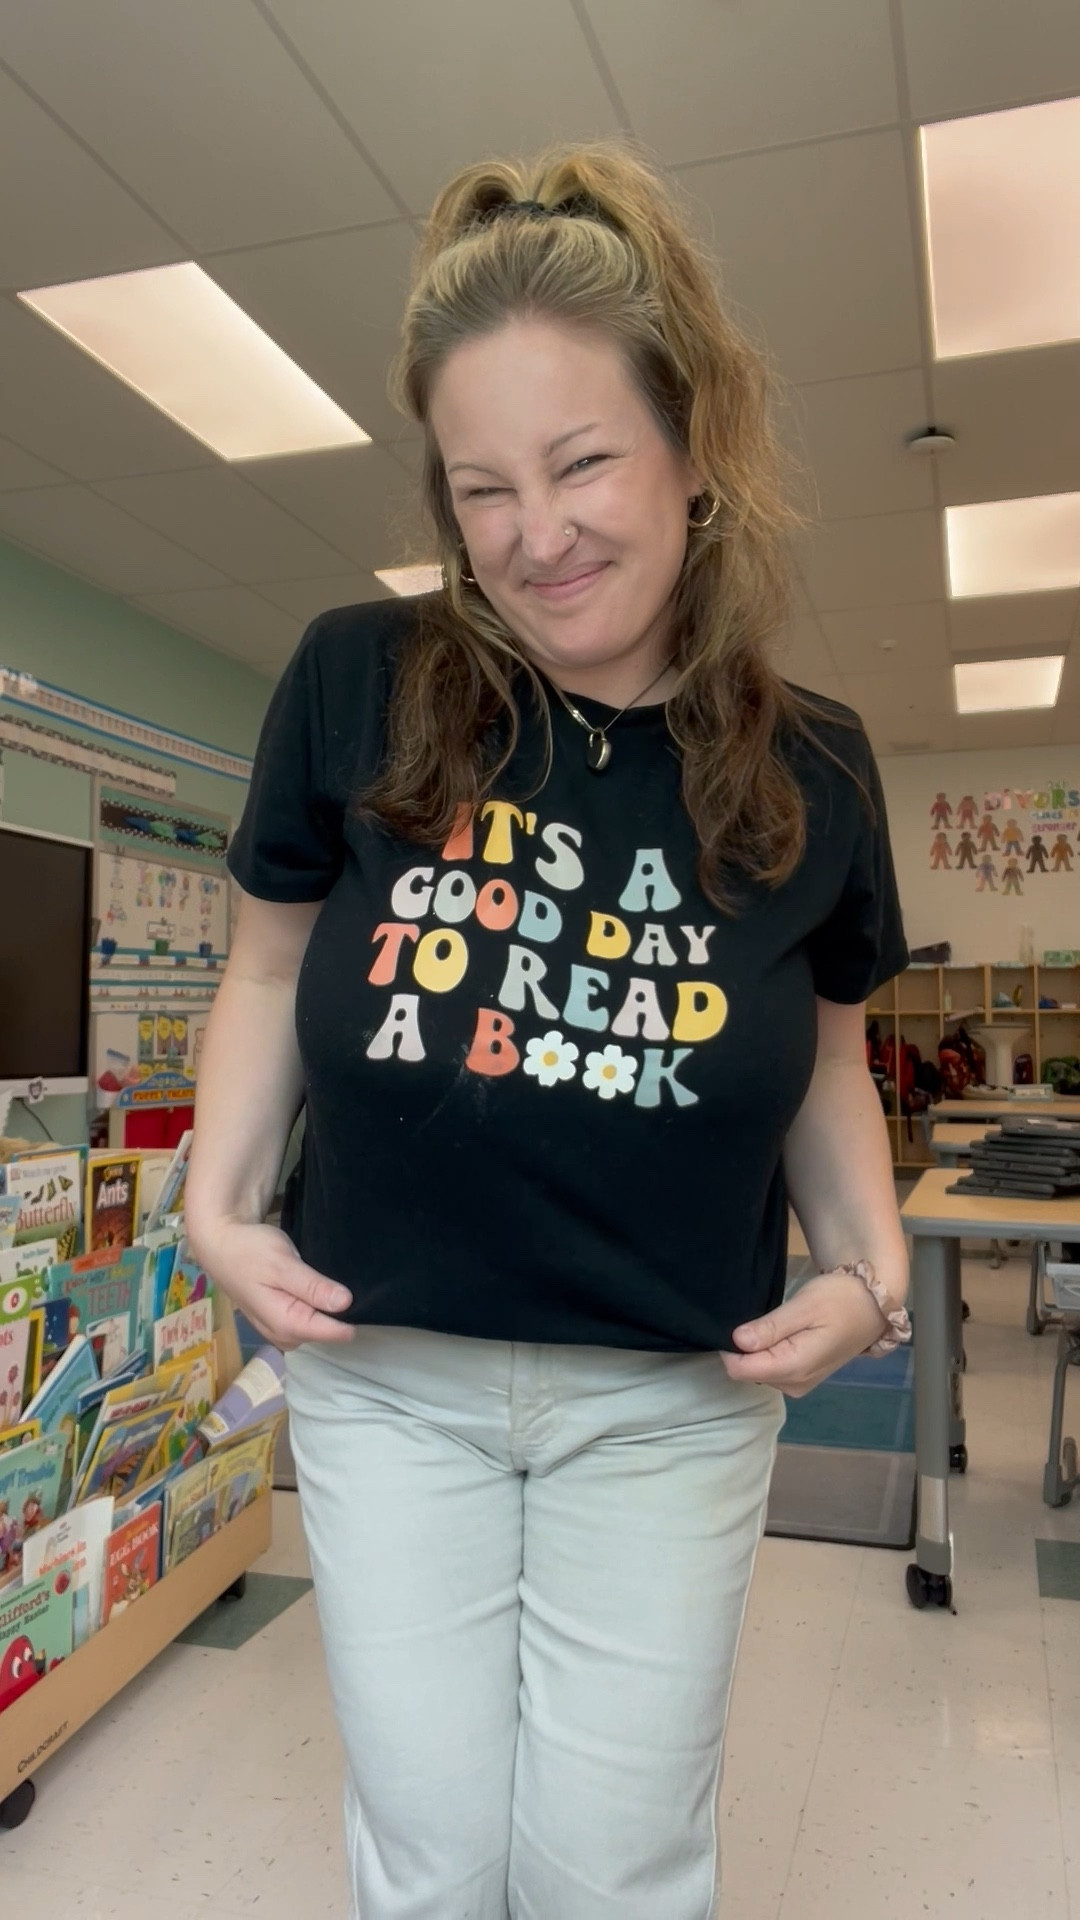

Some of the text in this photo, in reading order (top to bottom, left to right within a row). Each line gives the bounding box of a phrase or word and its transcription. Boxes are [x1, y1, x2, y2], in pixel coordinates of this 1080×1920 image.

[442, 799, 682, 912] IT'S A
[391, 866, 717, 966] GOOD DAY
[367, 922, 728, 1043] TO READ
[366, 994, 426, 1062] A
[16, 1196, 75, 1232] Butterfly
[96, 1178, 130, 1211] Ants
